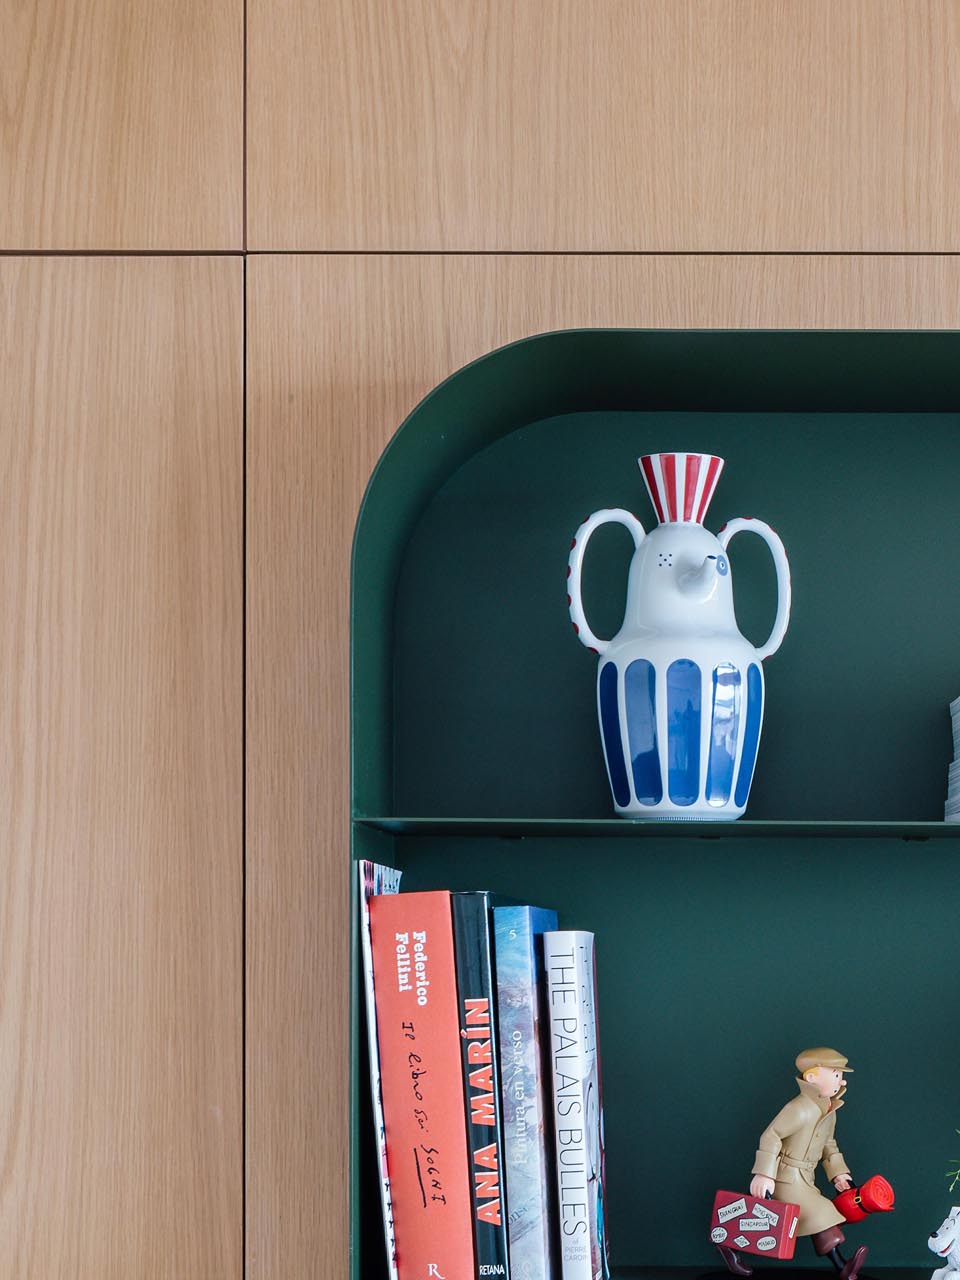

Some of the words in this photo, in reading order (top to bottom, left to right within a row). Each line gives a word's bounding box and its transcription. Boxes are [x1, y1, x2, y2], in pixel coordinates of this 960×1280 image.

[395, 932, 412, 992] Fellini
[508, 929, 517, 940] 5
[412, 931, 430, 1006] Federico
[550, 947, 576, 1005] THE
[460, 998, 496, 1127] MARÍN
[512, 1030, 523, 1074] verso
[553, 1018, 581, 1116] PALAIS
[514, 1081, 525, 1100] en
[513, 1106, 528, 1164] Pintura
[474, 1143, 502, 1226] ANA
[558, 1129, 587, 1236] BULLES
[479, 1264, 505, 1275] RETANA
